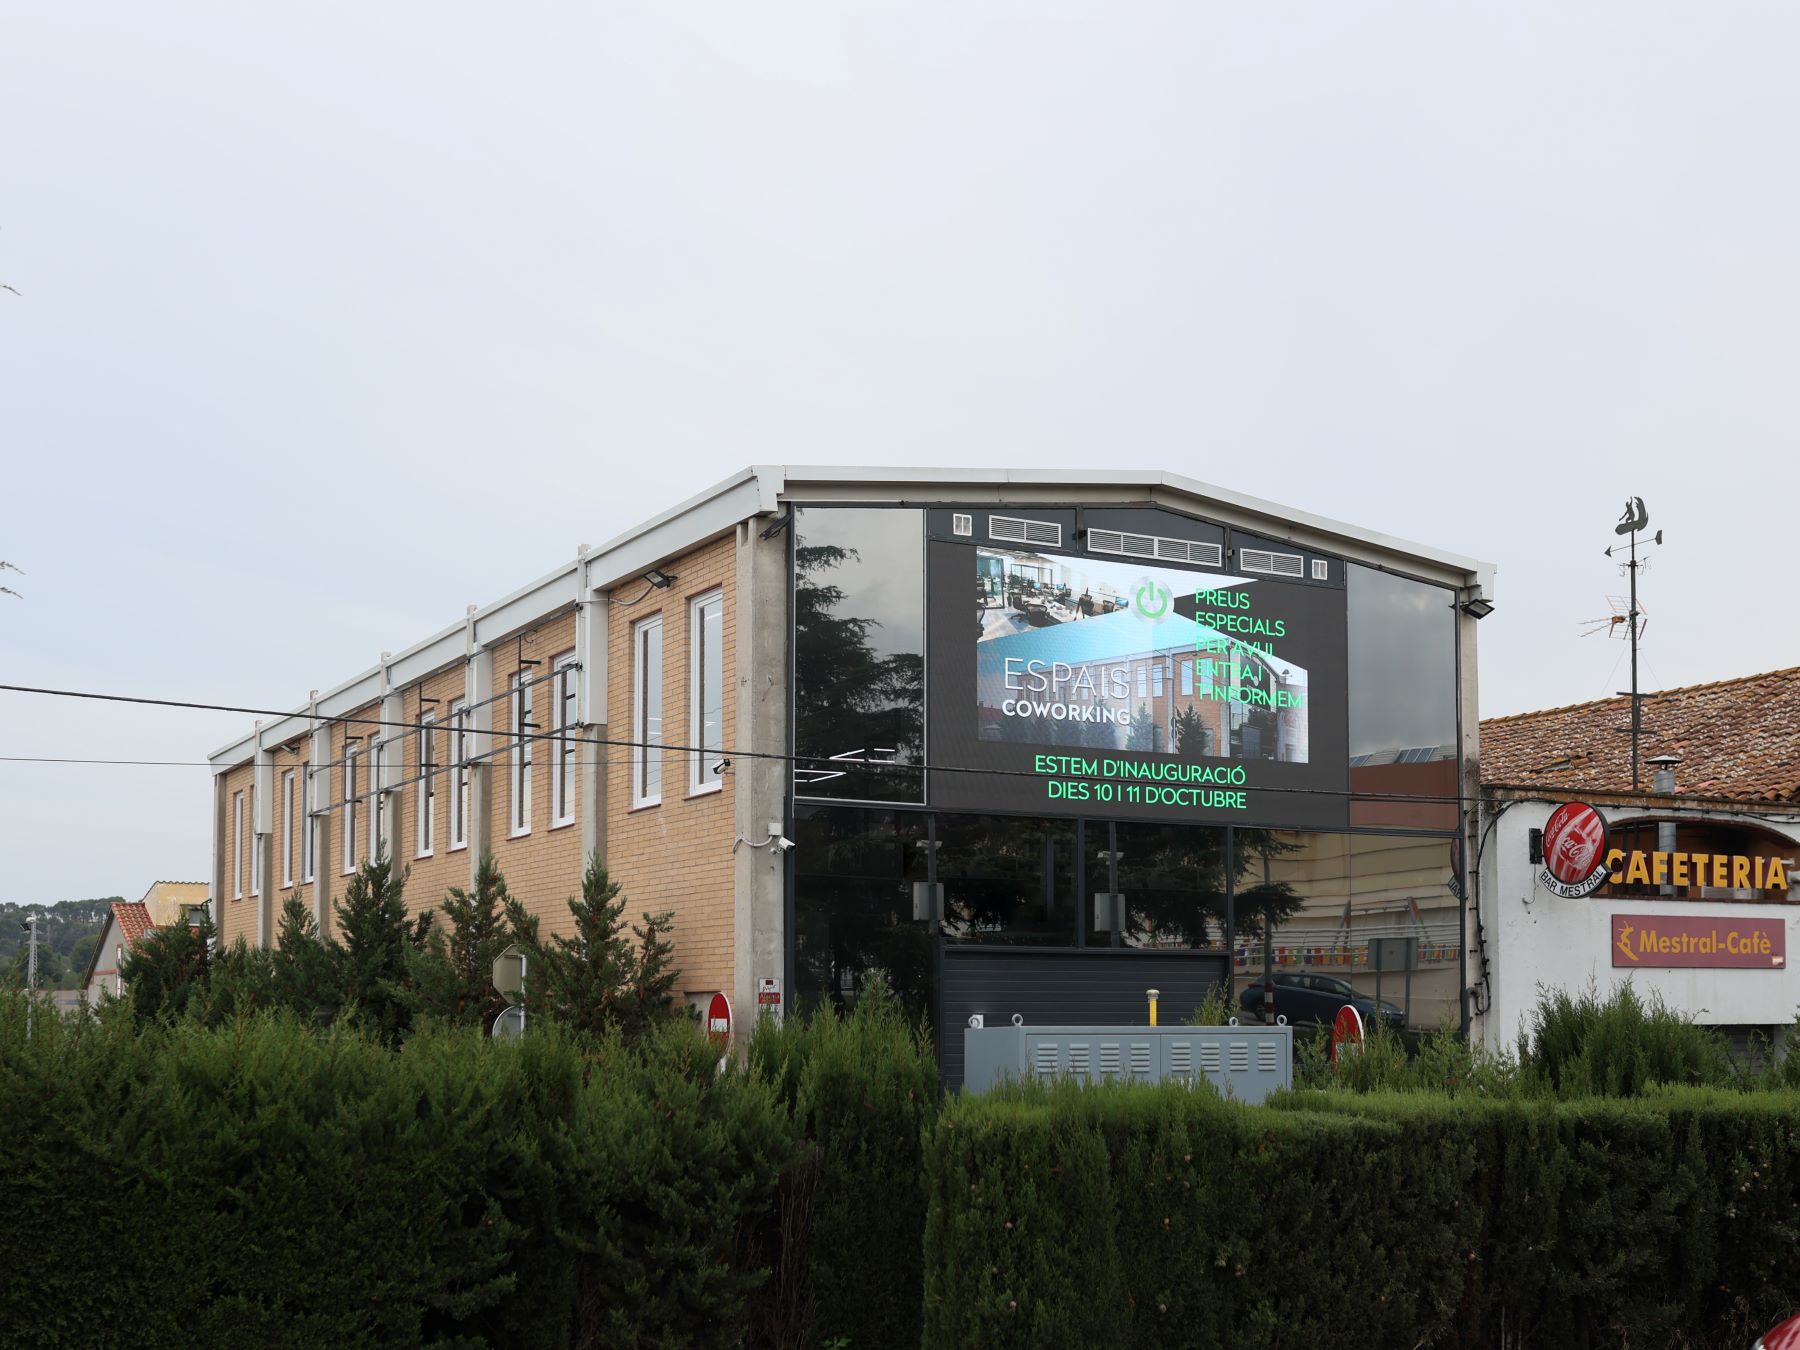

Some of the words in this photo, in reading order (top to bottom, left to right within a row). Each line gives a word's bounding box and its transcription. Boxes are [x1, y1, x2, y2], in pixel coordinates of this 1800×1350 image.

[1195, 588, 1250, 610] PREUS
[1195, 611, 1286, 637] ESPECIALS
[1003, 656, 1130, 700] ESPAIS
[1001, 699, 1131, 725] COWORKING
[1035, 754, 1098, 777] ESTEM
[1103, 758, 1247, 786] D'INAUGURACIÓ
[1047, 780, 1090, 801] DIES
[1093, 783, 1113, 802] 10
[1127, 785, 1141, 804] 11
[1145, 787, 1247, 809] D'OCTUBRE
[1606, 848, 1788, 890] CAFETERIA
[1540, 870, 1558, 891] BAR
[1559, 870, 1604, 897] MESTRAL
